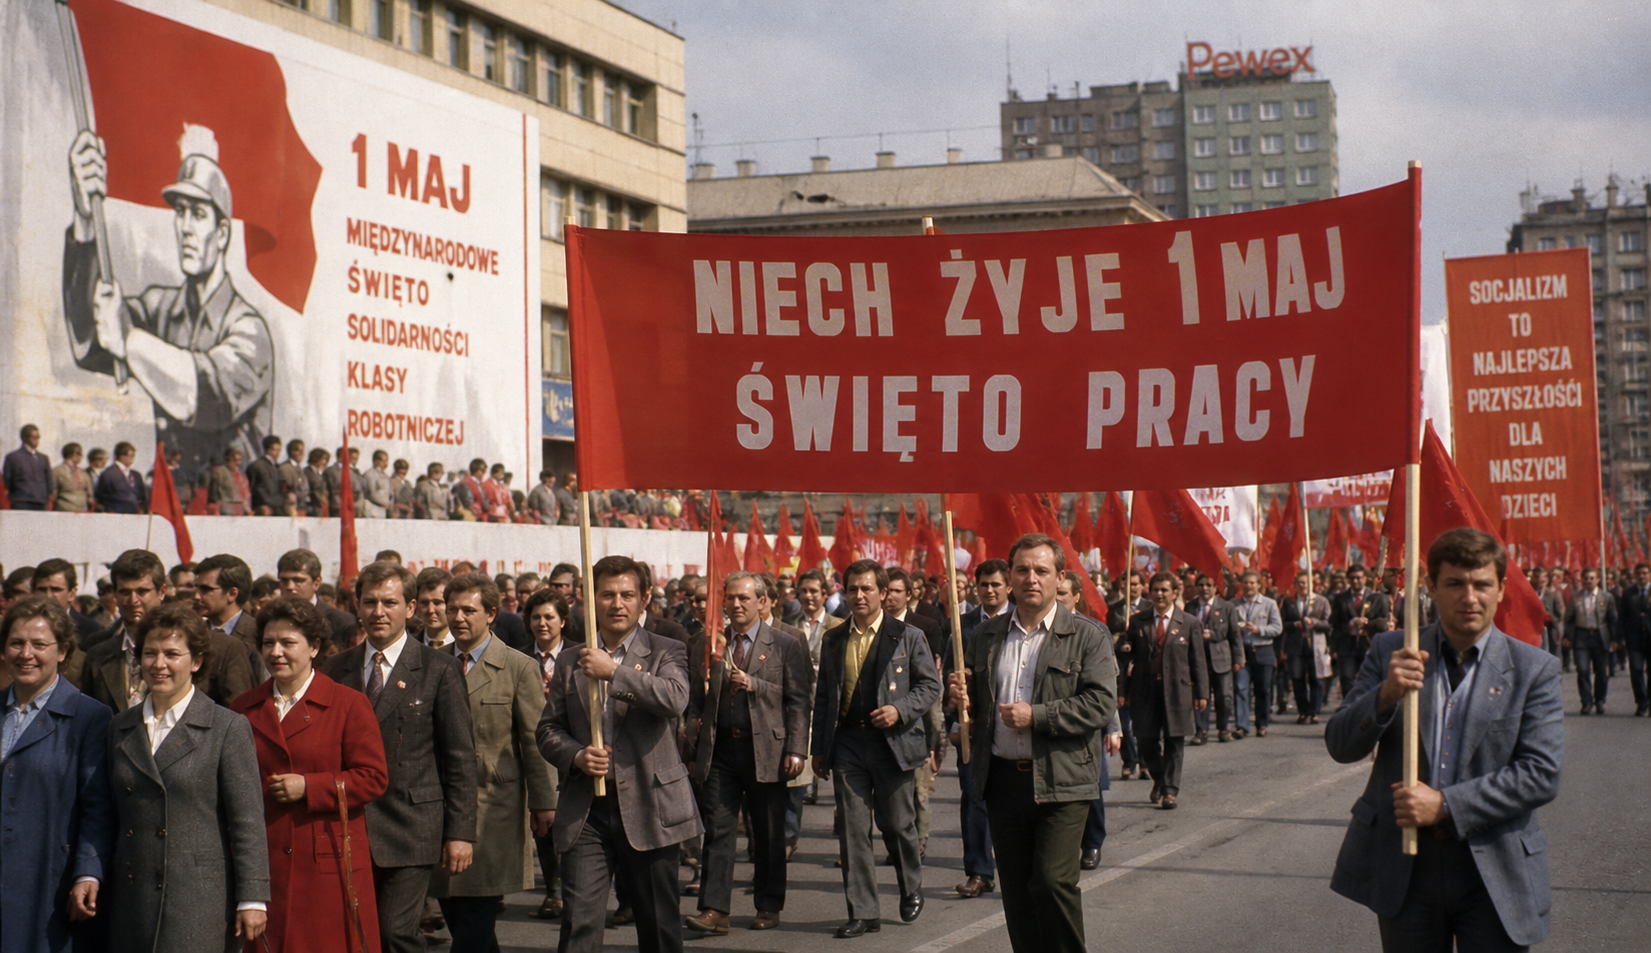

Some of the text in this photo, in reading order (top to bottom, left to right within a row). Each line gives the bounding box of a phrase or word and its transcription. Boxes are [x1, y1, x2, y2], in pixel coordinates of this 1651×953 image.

[1186, 41, 1315, 81] Pewex
[351, 132, 471, 214] 1 MAJ
[346, 217, 499, 276] MIĘDZYNARODOWE
[347, 260, 429, 306] ŚWIĘTO
[692, 225, 1345, 337] NIECH ŻYJE 1 MAJ
[1469, 273, 1568, 305] SOCJALIZM
[347, 313, 469, 357] SOLIDARNOŚCI
[1508, 312, 1532, 338] TO
[347, 360, 408, 394] KLASY
[1473, 346, 1573, 376] NAJLEPSZA
[736, 354, 1316, 463] ŚWIĘTO PRACY
[347, 409, 464, 446] ROBOTNICZEJ
[1508, 421, 1543, 447] DLA
[1489, 455, 1567, 483] NASZYCH
[1501, 492, 1557, 519] DZIECI
